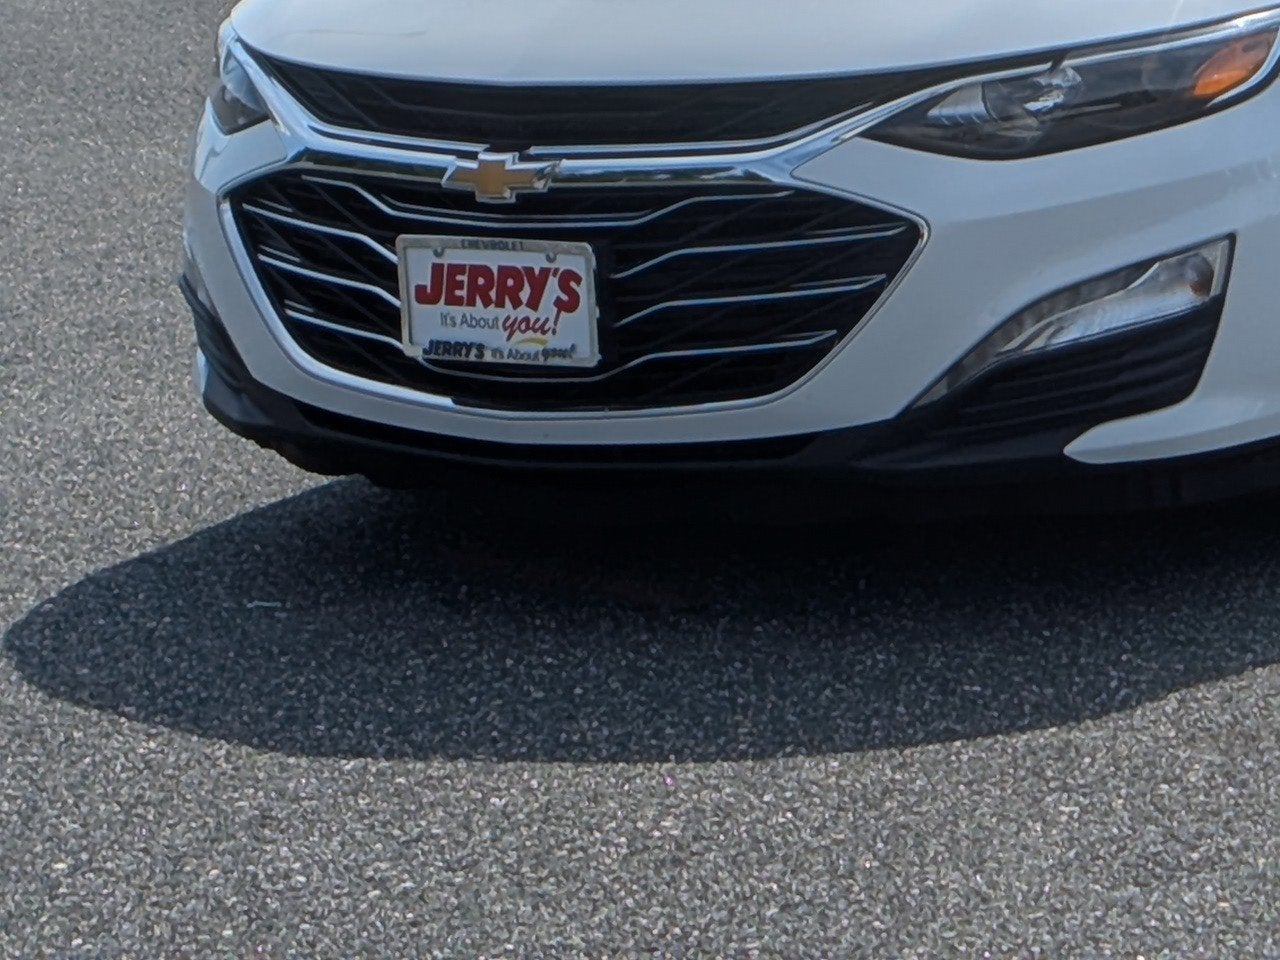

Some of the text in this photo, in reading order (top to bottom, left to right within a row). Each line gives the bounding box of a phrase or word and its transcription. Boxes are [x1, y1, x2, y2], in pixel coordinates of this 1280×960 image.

[461, 239, 526, 251] CHEVROLET
[414, 262, 583, 314] JERRY'S
[440, 309, 562, 342] It's About you!
[422, 339, 486, 360] JERRY'S
[506, 348, 540, 362] About
